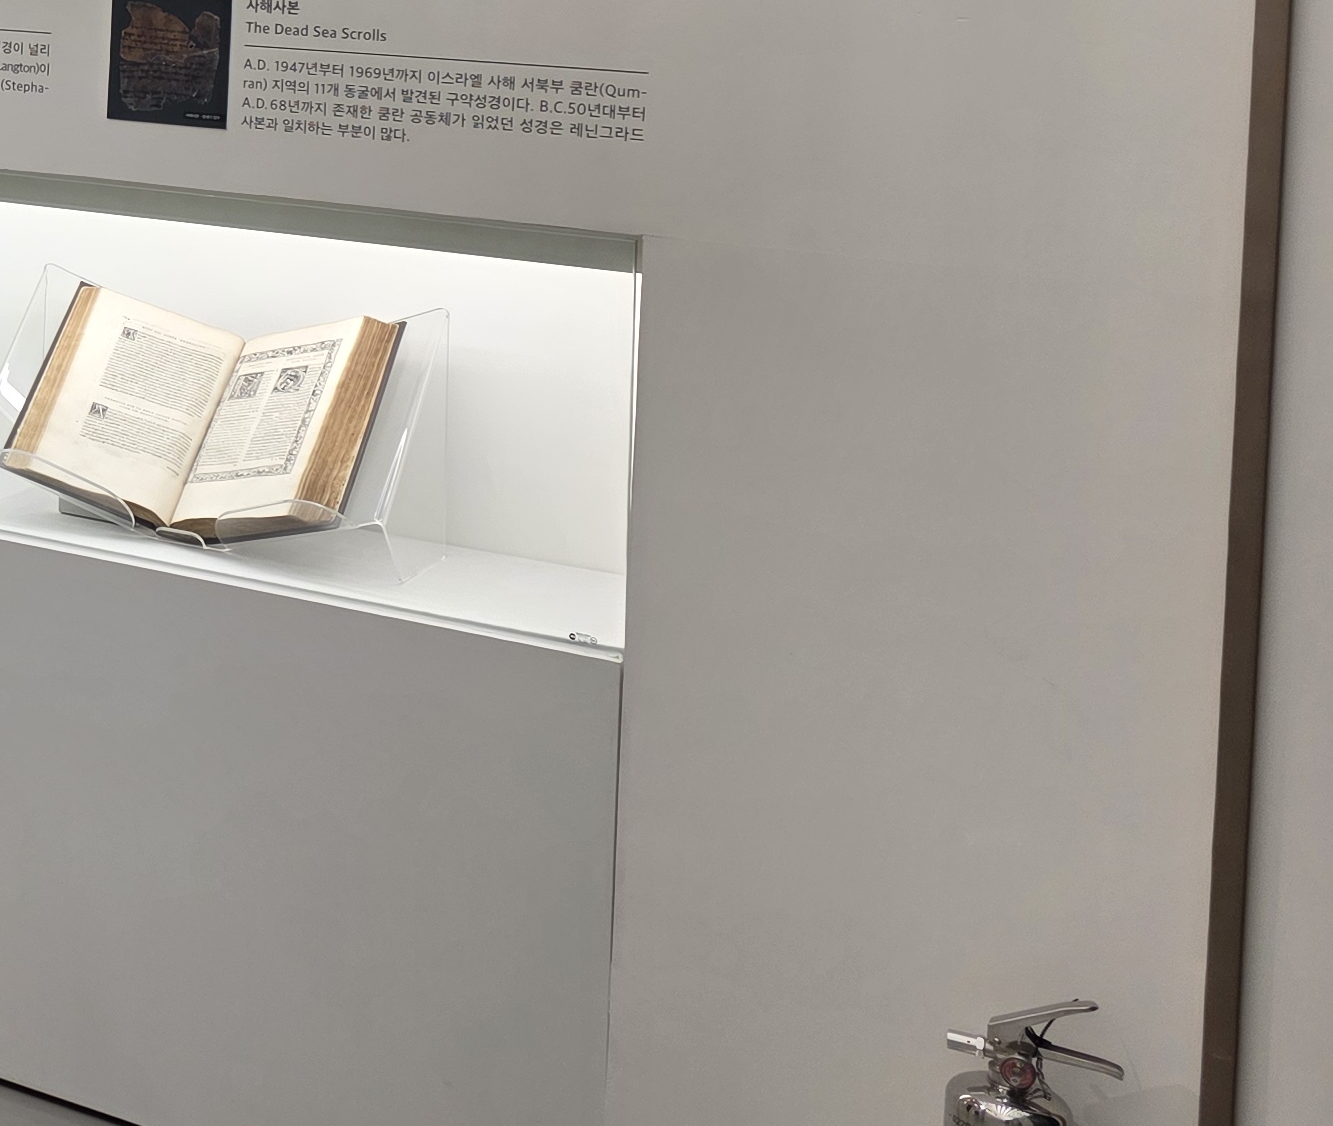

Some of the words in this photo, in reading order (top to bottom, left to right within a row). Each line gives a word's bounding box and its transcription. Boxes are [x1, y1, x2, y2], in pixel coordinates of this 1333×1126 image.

[245, 21, 270, 34] The
[275, 23, 308, 37] Dead
[313, 25, 337, 39] Sea
[341, 27, 387, 42] Scrolls
[243, 58, 270, 71] A.D.
[275, 60, 344, 78] 1947년부터
[349, 66, 422, 84] 1969년까지
[427, 70, 482, 88] 이스라엘
[487, 75, 515, 91] 사해
[521, 77, 564, 94] 서북부
[569, 80, 647, 99] 쿰란(Qum-
[243, 78, 268, 91] ran)
[271, 78, 310, 95] 지역의
[315, 83, 339, 97] 11개
[343, 84, 396, 102] 동굴에서
[401, 89, 441, 105] 발견된
[445, 92, 534, 113] 구약성경이다.
[539, 99, 646, 122] B.C.50년대부터
[241, 115, 278, 132] 사본과
[283, 119, 334, 136] 일치하는
[337, 123, 376, 140] 부분이
[380, 127, 410, 143] 많다.
[332, 103, 373, 120] 존재한
[377, 106, 405, 123] 쿰란
[409, 109, 466, 128] 공동체가
[472, 114, 513, 131] 읽었던
[519, 118, 564, 136] 성경은
[569, 123, 644, 142] 레닌그라드
